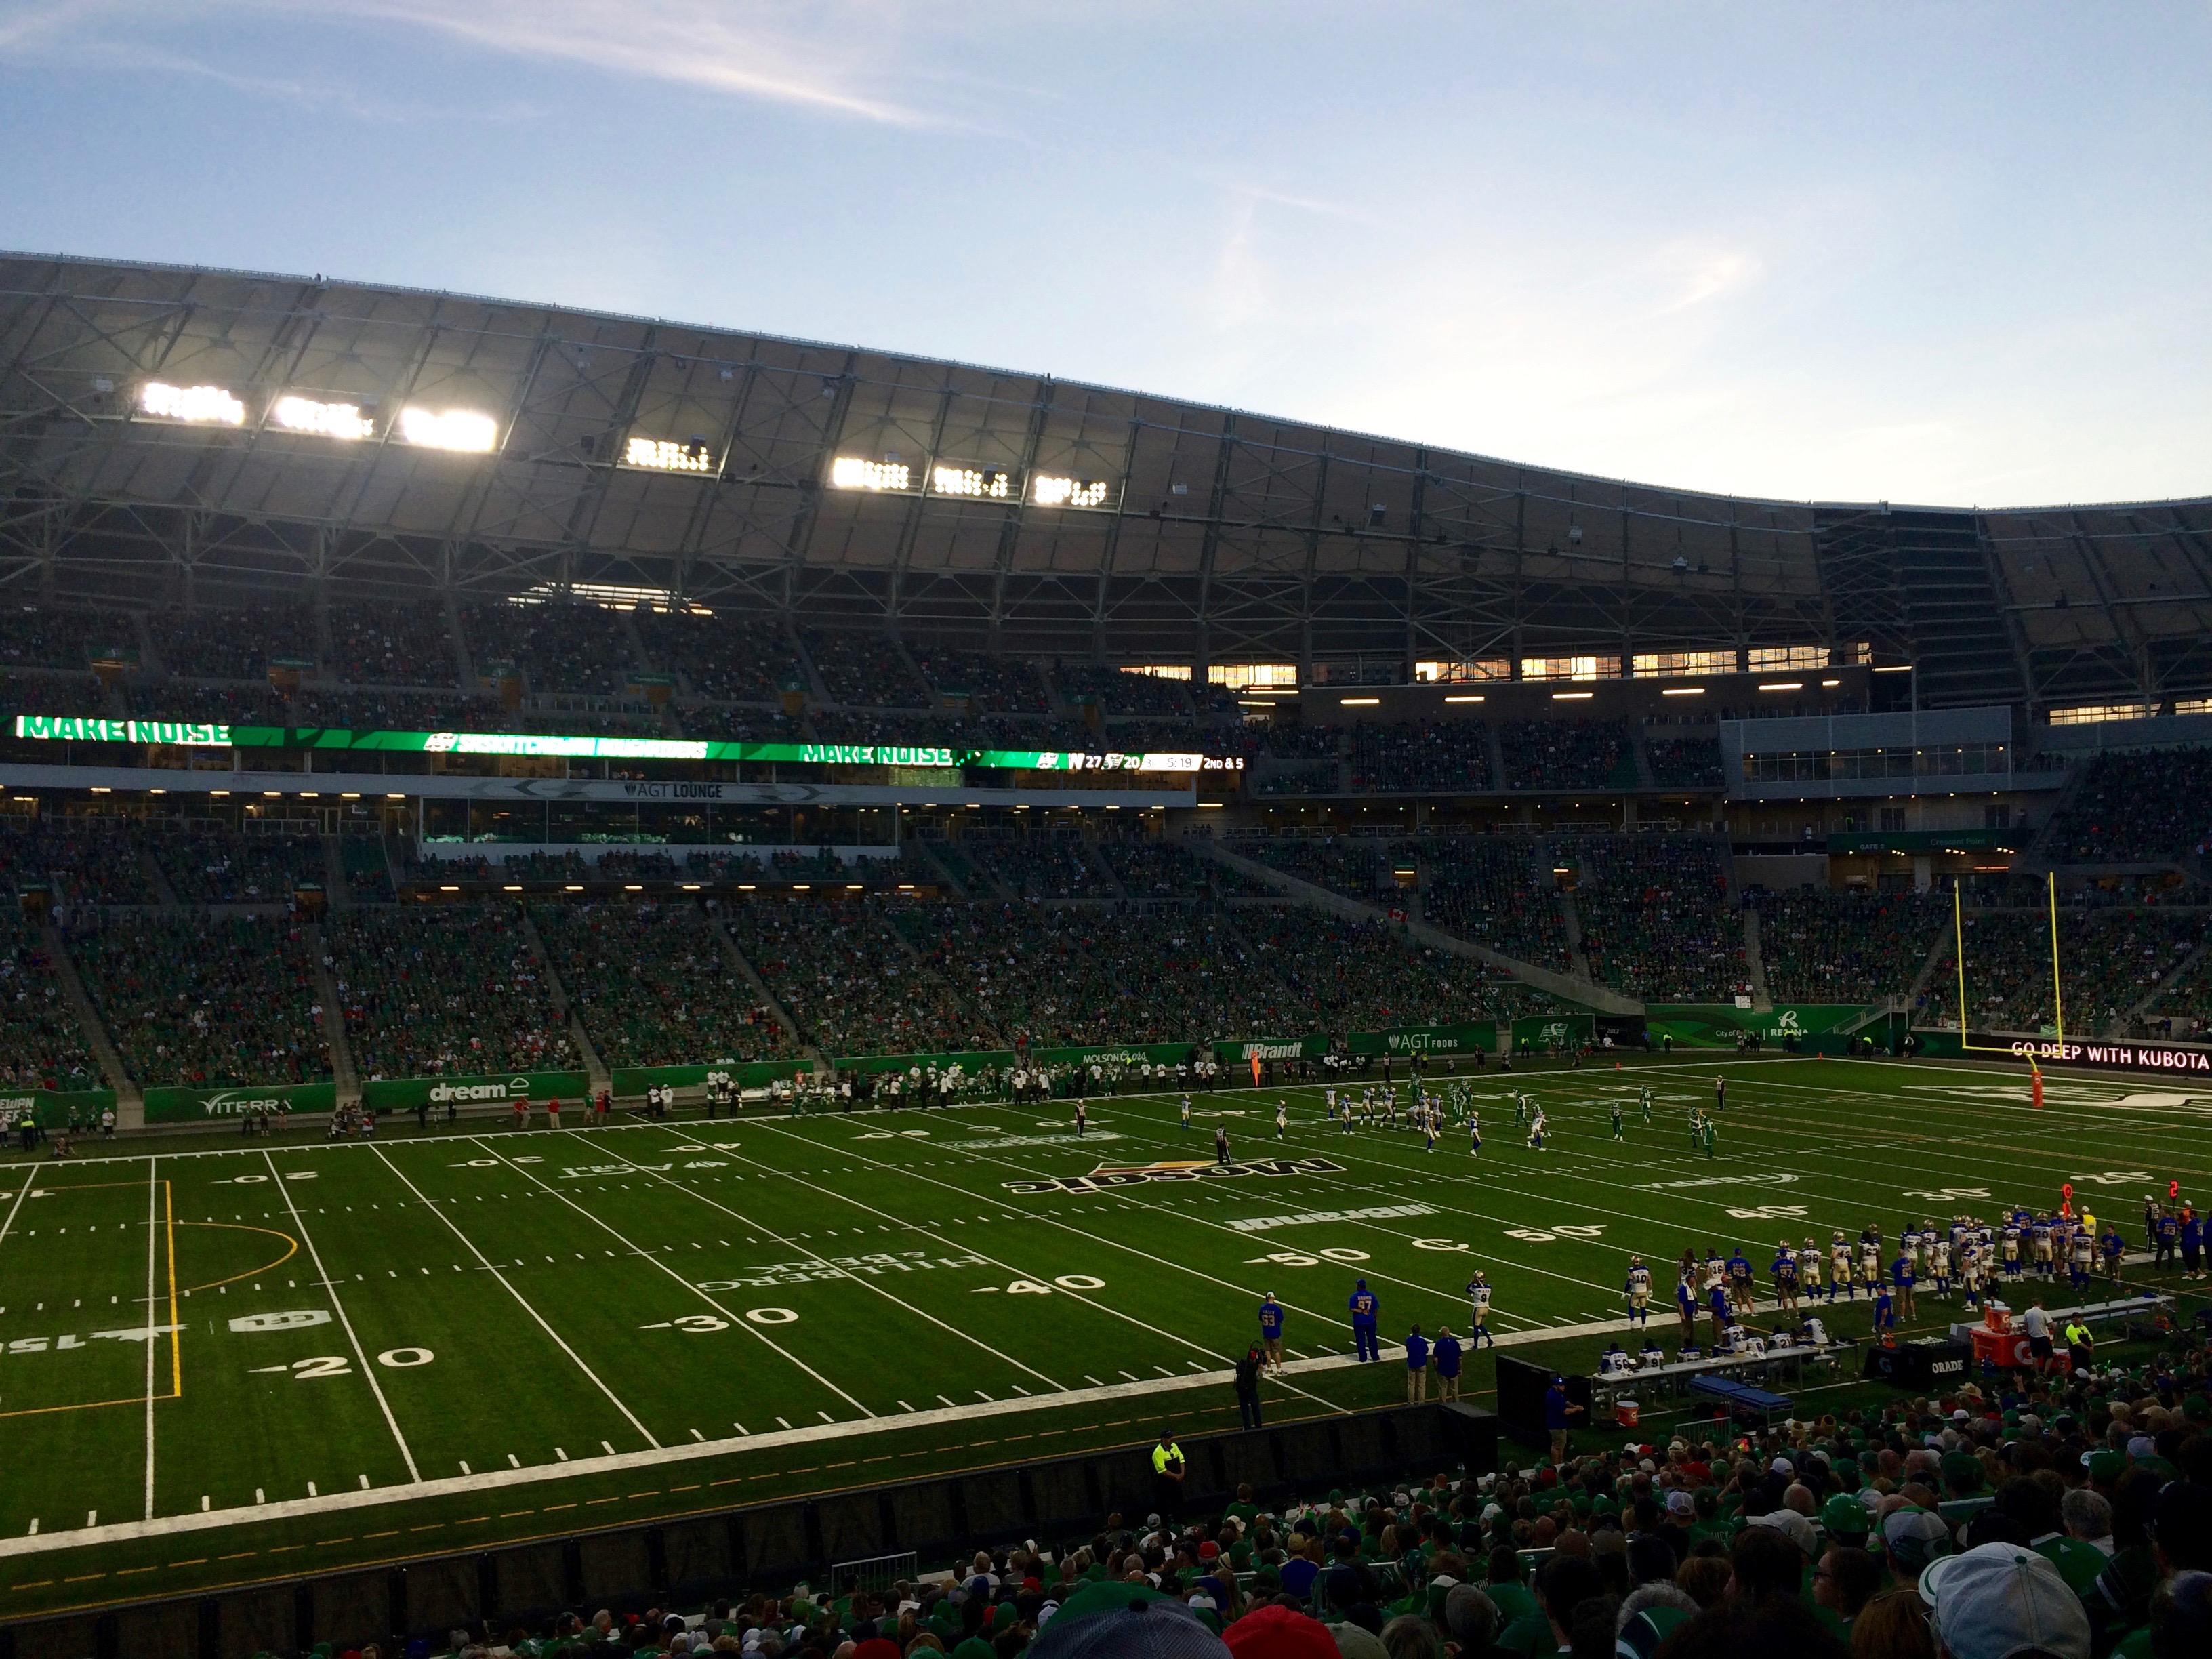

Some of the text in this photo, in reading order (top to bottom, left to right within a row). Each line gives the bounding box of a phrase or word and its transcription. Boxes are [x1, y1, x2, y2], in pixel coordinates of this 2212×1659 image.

[16, 716, 232, 746] MAKE NOISE
[799, 745, 953, 765] MAKE NOISE
[1086, 756, 1101, 768] 27
[1124, 756, 1140, 769] 20
[1167, 758, 1192, 768] 5:19
[1204, 758, 1223, 769] 2ND
[1225, 758, 1234, 769] &
[1235, 758, 1244, 769] 5
[637, 783, 722, 798] AGT LOUNGE
[1401, 1033, 1458, 1050] AGT FOODS
[1083, 1050, 1146, 1063] MOLSON Cors
[1253, 1042, 1303, 1059] Brandt
[2011, 1041, 2210, 1070] GO DEEP WITH KUBOTA
[429, 1082, 506, 1101] dream
[1002, 1157, 1348, 1195] Mosaic
[1902, 1188, 1992, 1201] 30
[1725, 1206, 1809, 1219] 40
[1502, 1225, 1603, 1242] 50
[1411, 1238, 1469, 1251] C
[1266, 1248, 1372, 1267] 50
[1681, 1266, 1695, 1275] 32
[1712, 1265, 1723, 1275] 16
[1006, 1275, 1106, 1295] 40
[1635, 1275, 1647, 1284] 10
[674, 1307, 800, 1332] 30
[0, 1334, 87, 1355] 15
[291, 1347, 435, 1379] 20
[1932, 1359, 1963, 1374] ORADE
